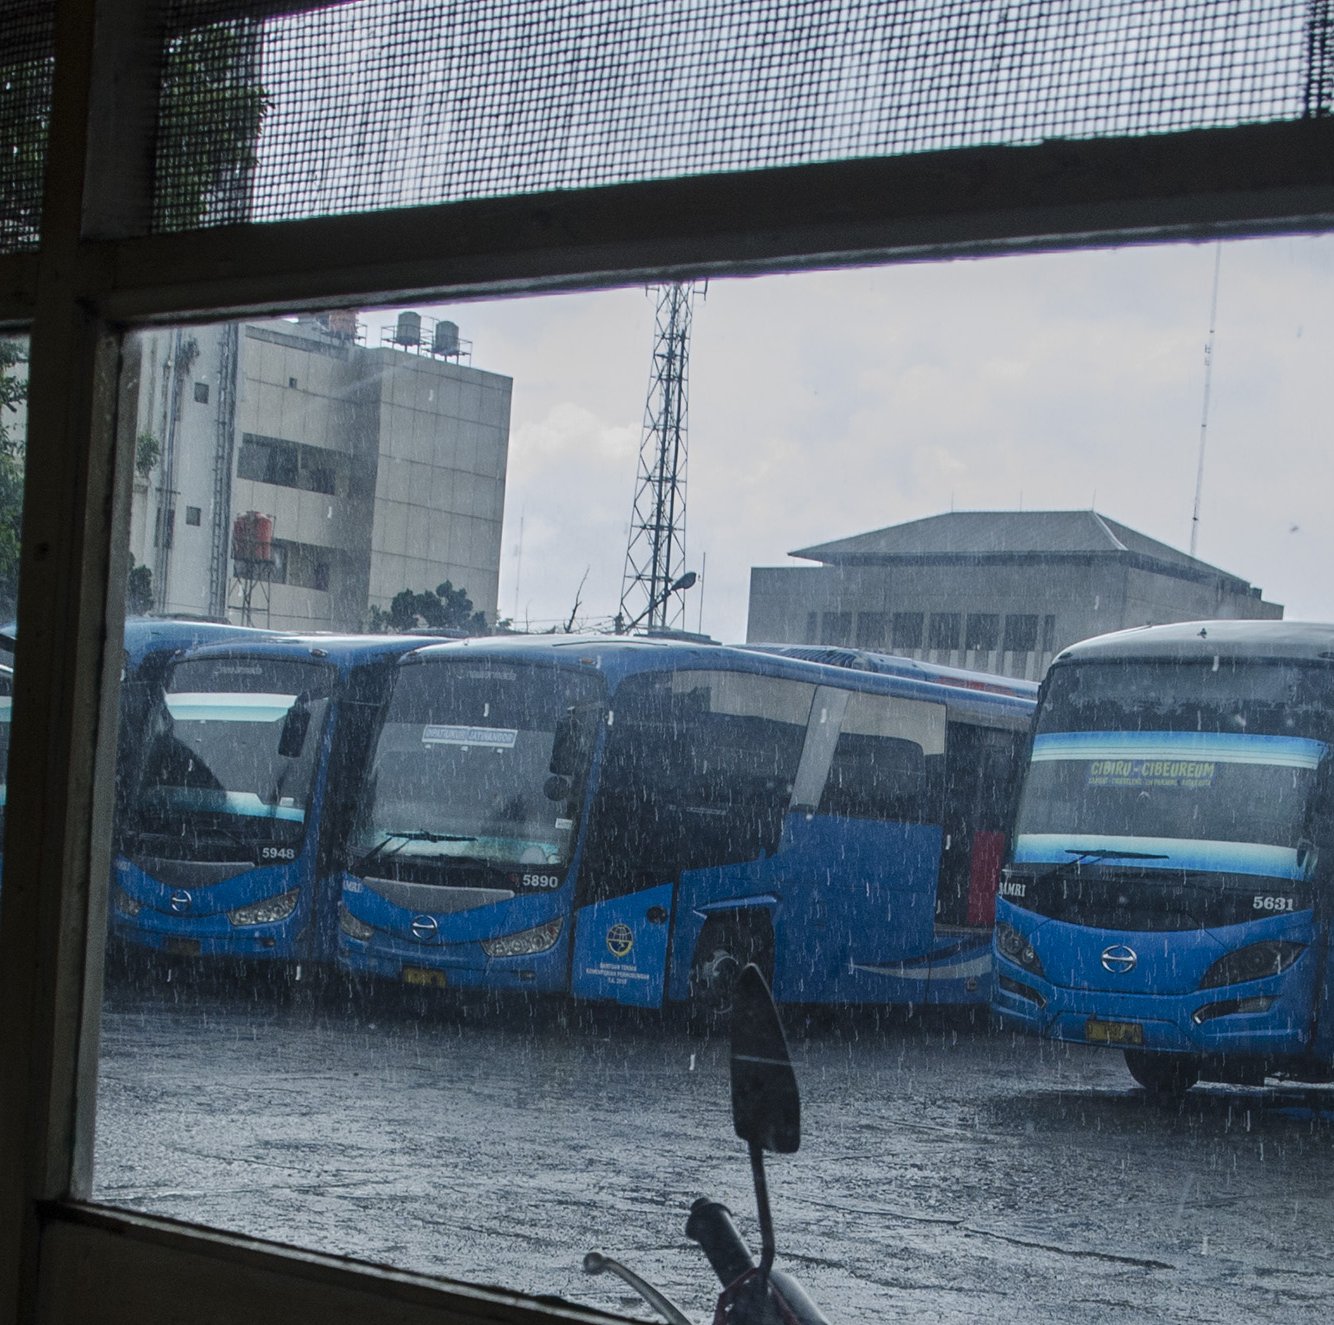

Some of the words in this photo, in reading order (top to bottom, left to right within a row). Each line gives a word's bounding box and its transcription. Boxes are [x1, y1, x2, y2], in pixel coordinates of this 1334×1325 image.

[1090, 760, 1132, 777] CIBIRU
[1141, 761, 1215, 778] CIBEUREUM
[261, 847, 295, 860] 5948
[522, 873, 559, 888] 5890
[1253, 896, 1295, 911] 5631
